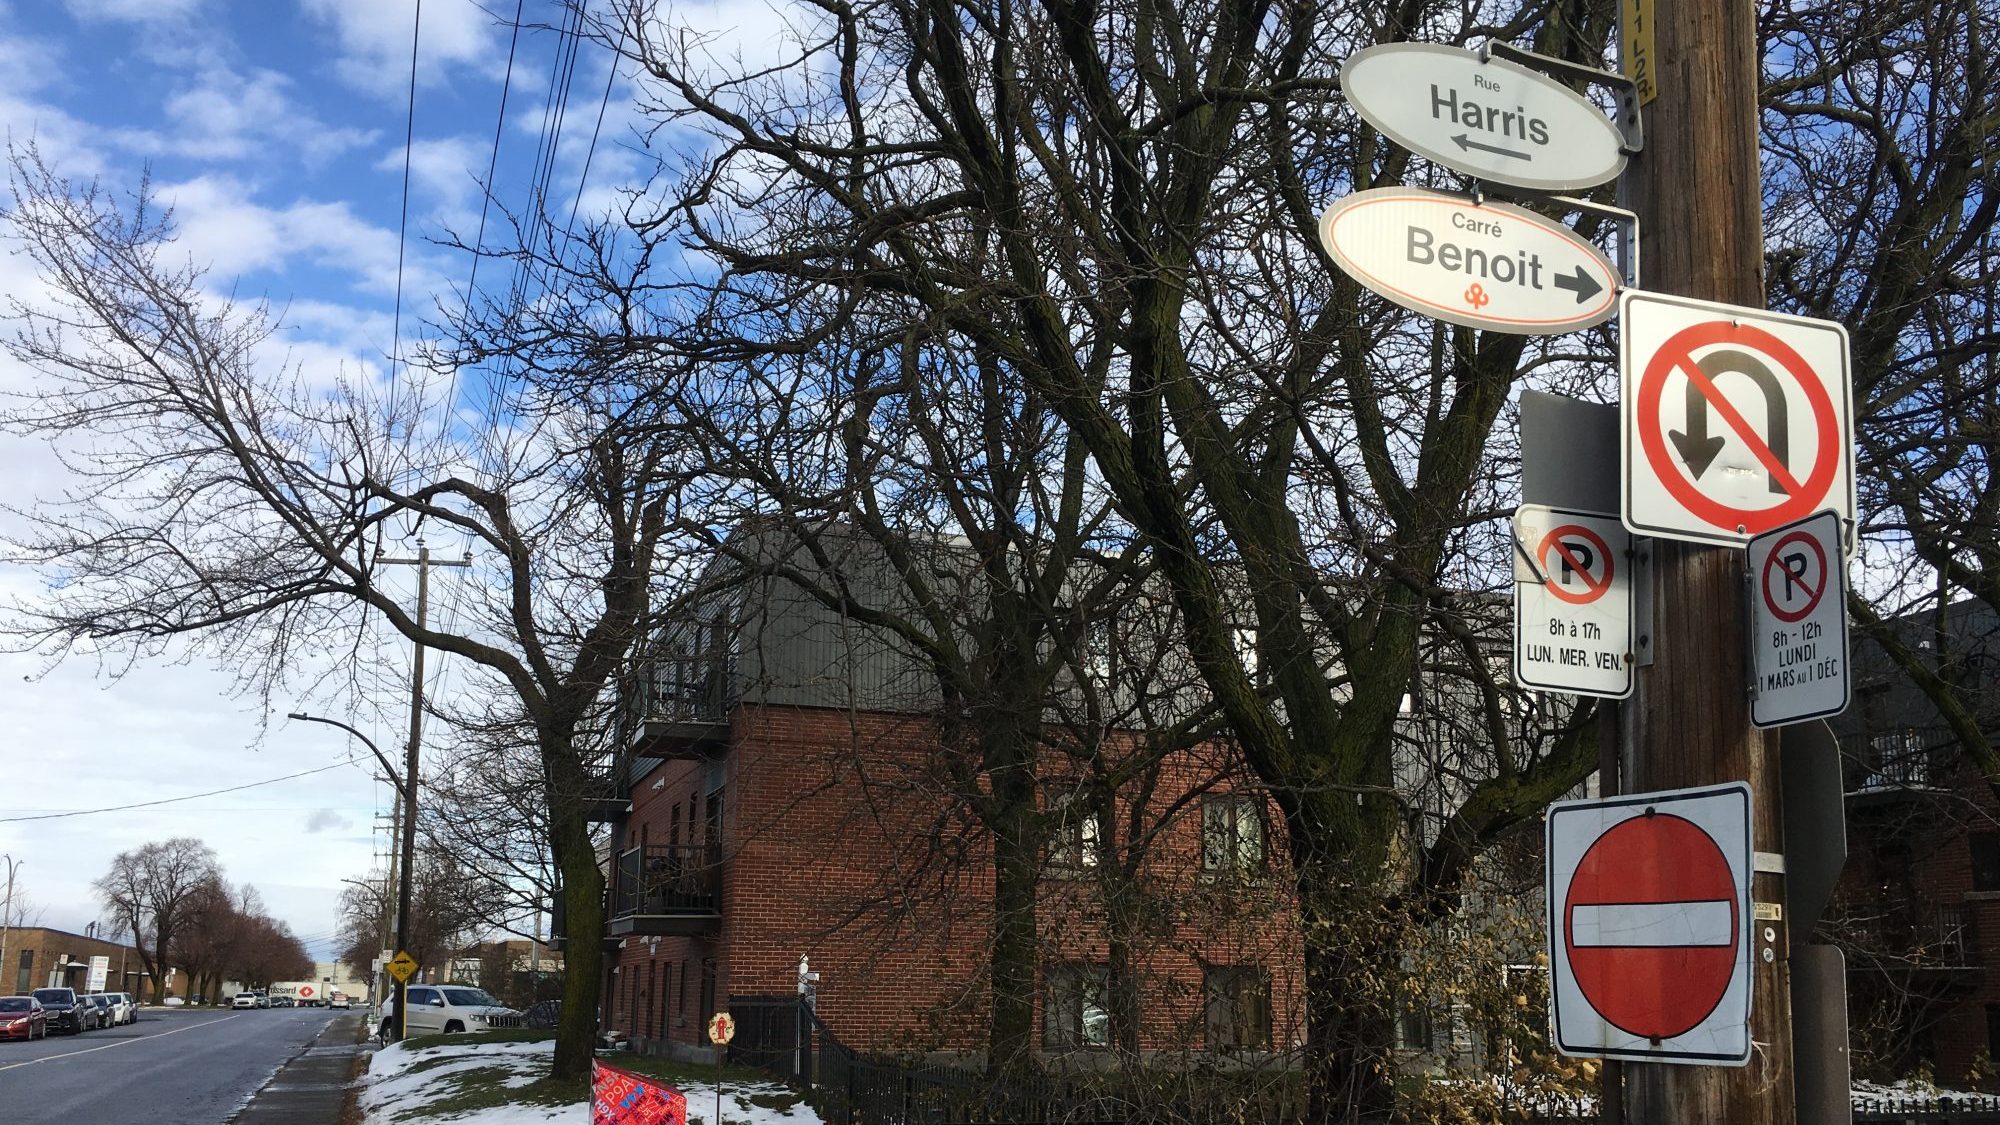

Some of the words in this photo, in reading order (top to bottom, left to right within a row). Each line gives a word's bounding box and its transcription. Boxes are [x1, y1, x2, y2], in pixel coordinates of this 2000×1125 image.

[1474, 74, 1501, 92] Rue
[1430, 84, 1550, 146] Harris
[1452, 212, 1502, 238] Carré
[1407, 225, 1543, 290] Benoit
[1549, 618, 1565, 636] 8h
[1570, 620, 1577, 637] à
[1582, 622, 1601, 640] 17h
[1773, 630, 1788, 648] 8h
[1802, 621, 1822, 641] 12h
[1527, 644, 1555, 663] LUN.
[1560, 648, 1590, 667] MER.
[1595, 651, 1622, 671] VEN.
[1779, 642, 1816, 668] LUNDI
[1768, 669, 1795, 691] MARS
[1797, 672, 1806, 685] AU
[1818, 656, 1838, 680] DÉC
[605, 1078, 634, 1106] P9A
[595, 1098, 616, 1121] H9X
